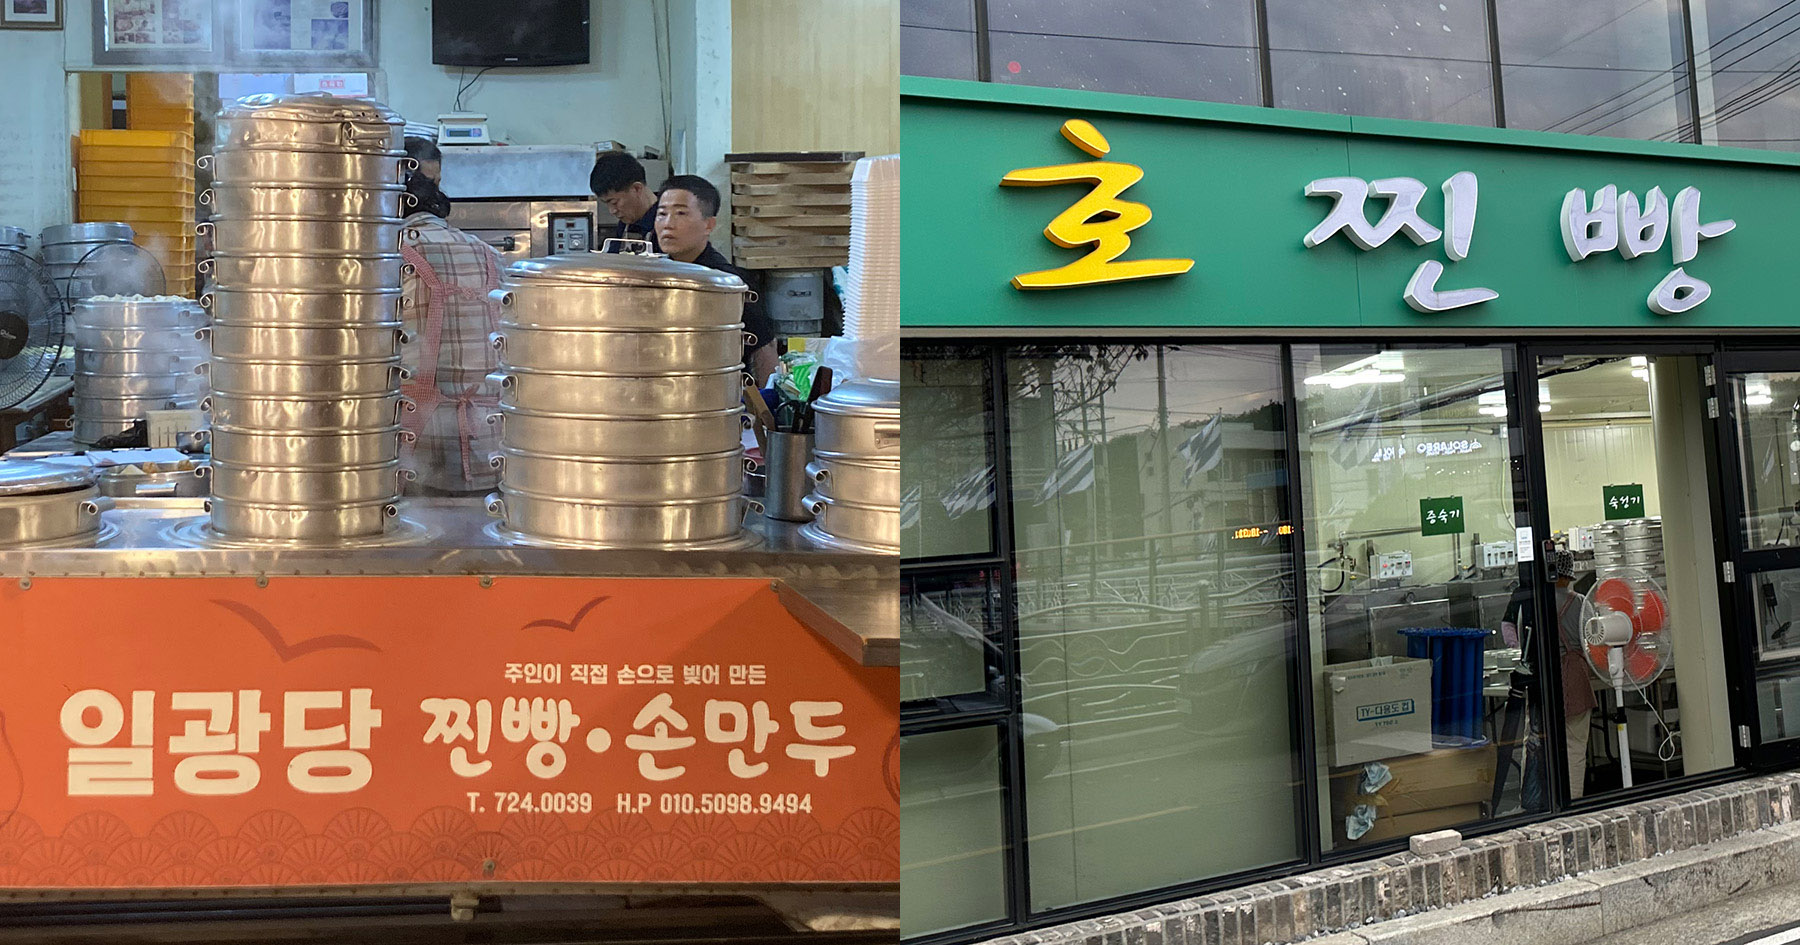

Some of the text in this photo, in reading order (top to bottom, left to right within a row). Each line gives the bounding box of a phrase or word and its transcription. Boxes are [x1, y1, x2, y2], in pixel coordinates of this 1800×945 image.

[999, 119, 1195, 290] 호
[1609, 495, 1641, 510] 숙성기
[1426, 508, 1460, 525] 증숙기
[504, 663, 767, 685] 주인이 직접 손으로 빚어 만든
[60, 688, 382, 797] 일광당
[466, 791, 813, 815] T. 724.0039 H.P 010.5098.9494
